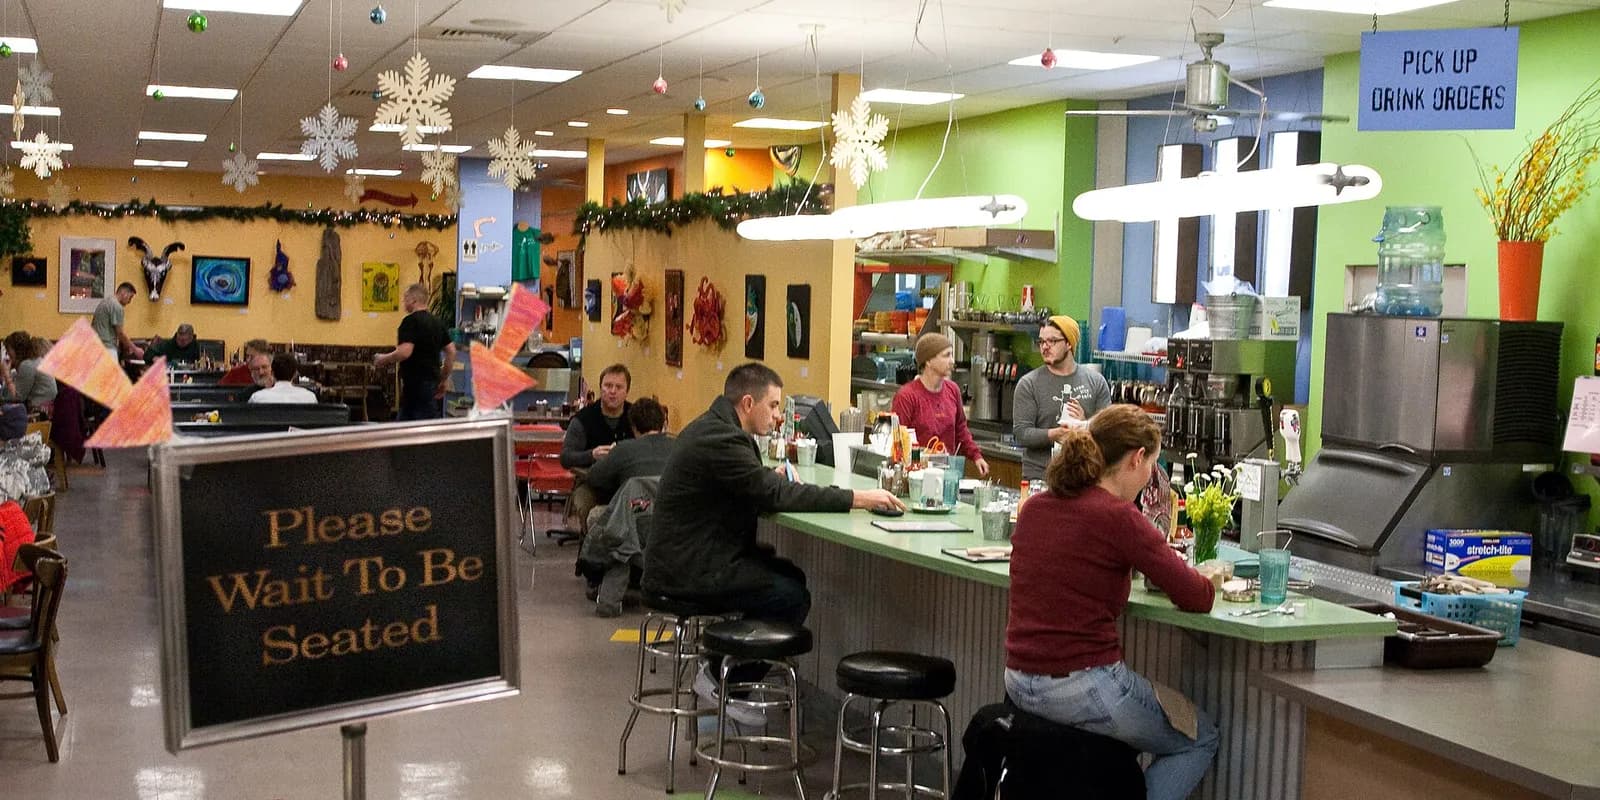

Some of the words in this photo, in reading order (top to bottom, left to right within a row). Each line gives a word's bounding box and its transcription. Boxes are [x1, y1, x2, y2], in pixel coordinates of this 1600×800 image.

[1402, 50, 1445, 75] PICK
[1452, 48, 1478, 74] UP
[1371, 87, 1425, 112] DRINK
[1432, 85, 1506, 112] ORDERS
[262, 505, 432, 549] Please
[1466, 544, 1513, 555] stretch-tite
[206, 564, 336, 614] Wait
[343, 556, 407, 596] To
[418, 548, 485, 588] Be
[261, 604, 443, 668] Seated
